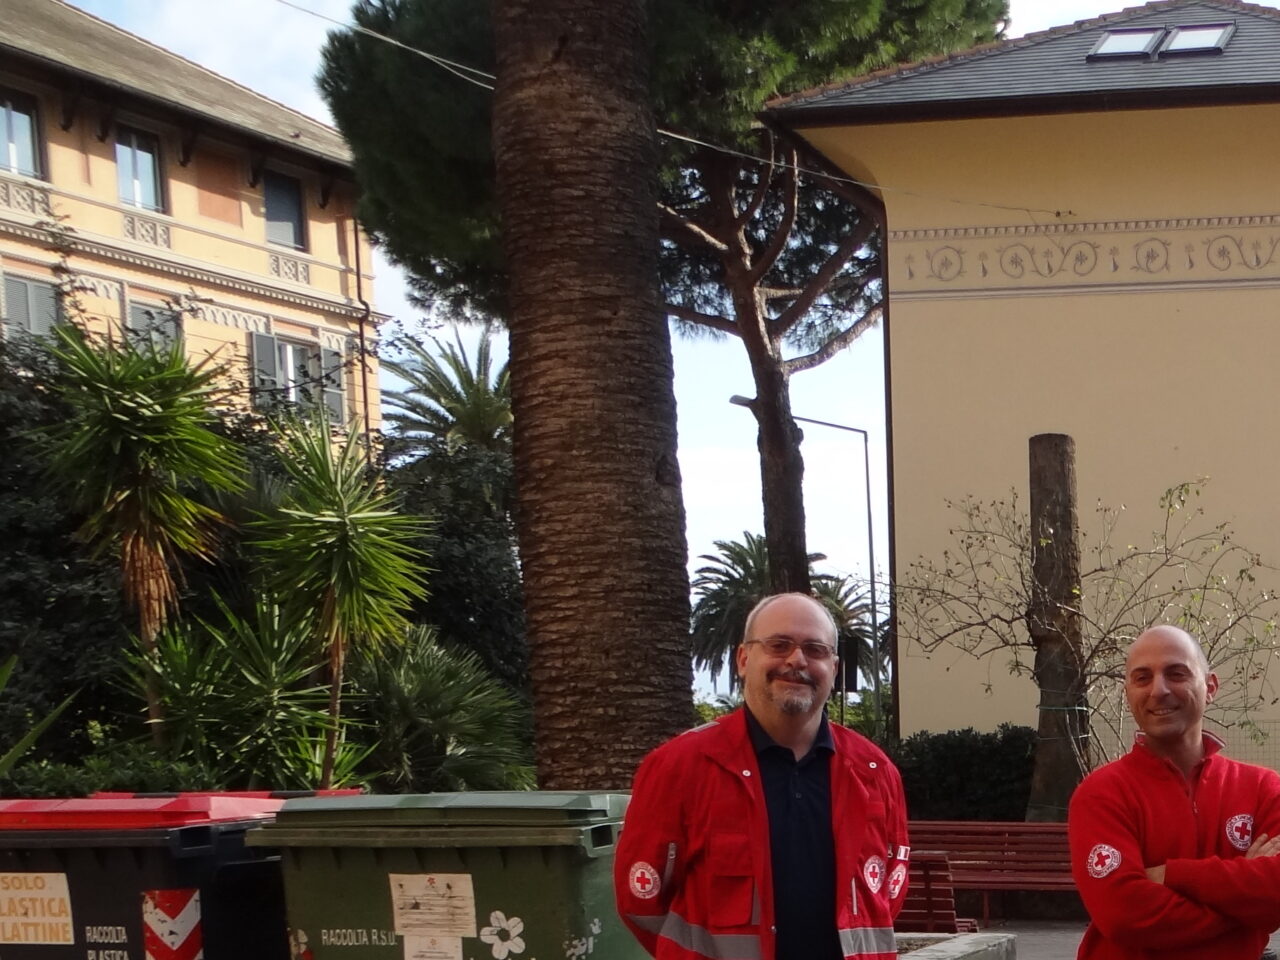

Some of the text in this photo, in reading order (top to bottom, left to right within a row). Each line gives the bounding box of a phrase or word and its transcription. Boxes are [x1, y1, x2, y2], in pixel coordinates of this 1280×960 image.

[1, 876, 45, 890] SOLO
[2, 922, 71, 942] LATTINE
[85, 926, 128, 943] RACCOLTA
[321, 929, 369, 946] RACCOLTA
